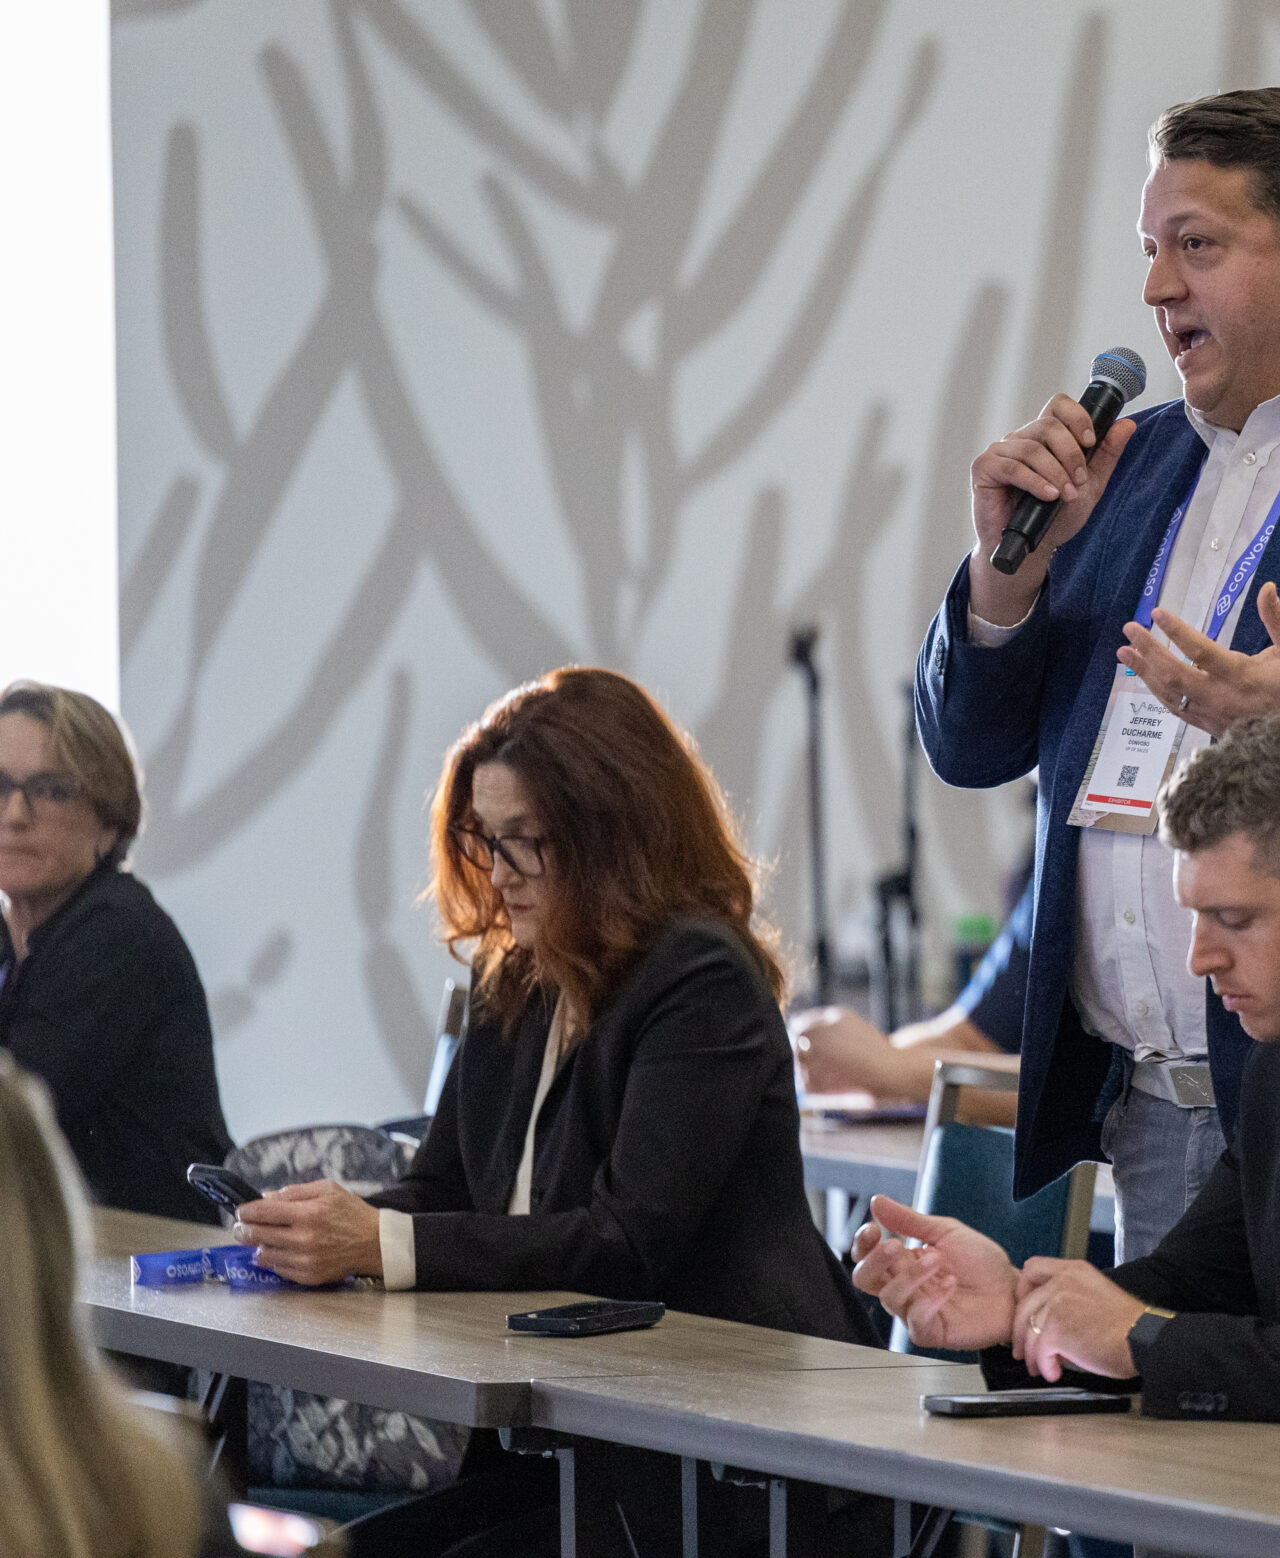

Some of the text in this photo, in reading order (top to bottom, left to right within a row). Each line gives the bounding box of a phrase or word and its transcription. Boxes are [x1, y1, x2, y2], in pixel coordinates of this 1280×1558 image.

[1228, 524, 1275, 593] convoso
[1129, 717, 1163, 727] JEFFREY
[1121, 727, 1163, 740] DUCHARME
